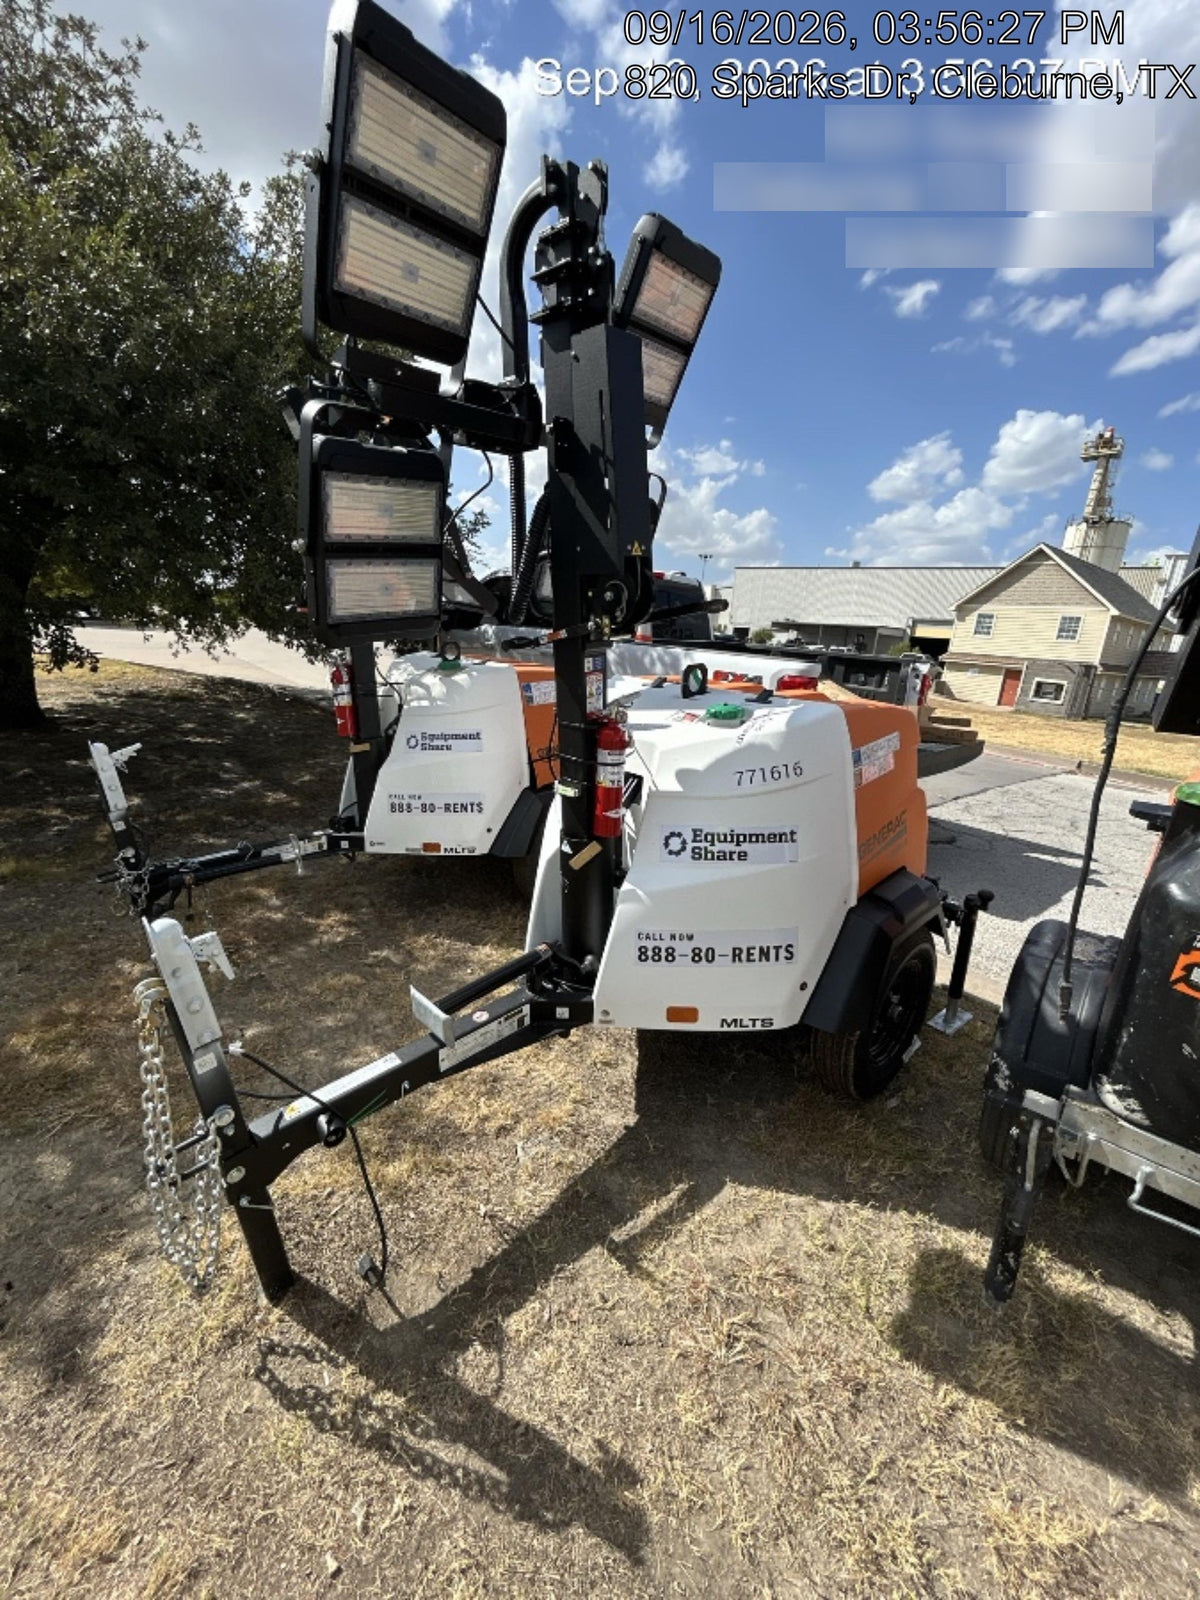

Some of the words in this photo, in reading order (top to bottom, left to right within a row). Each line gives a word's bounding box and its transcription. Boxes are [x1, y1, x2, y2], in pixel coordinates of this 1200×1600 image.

[421, 731, 482, 742] Equipment
[734, 760, 804, 786] 771616
[691, 828, 797, 846] Equipment
[691, 846, 748, 861] Share
[638, 932, 665, 942] CALL
[669, 932, 694, 941] NOW
[637, 944, 795, 963] 888-80-RENTS
[720, 1018, 774, 1029] MLTS
